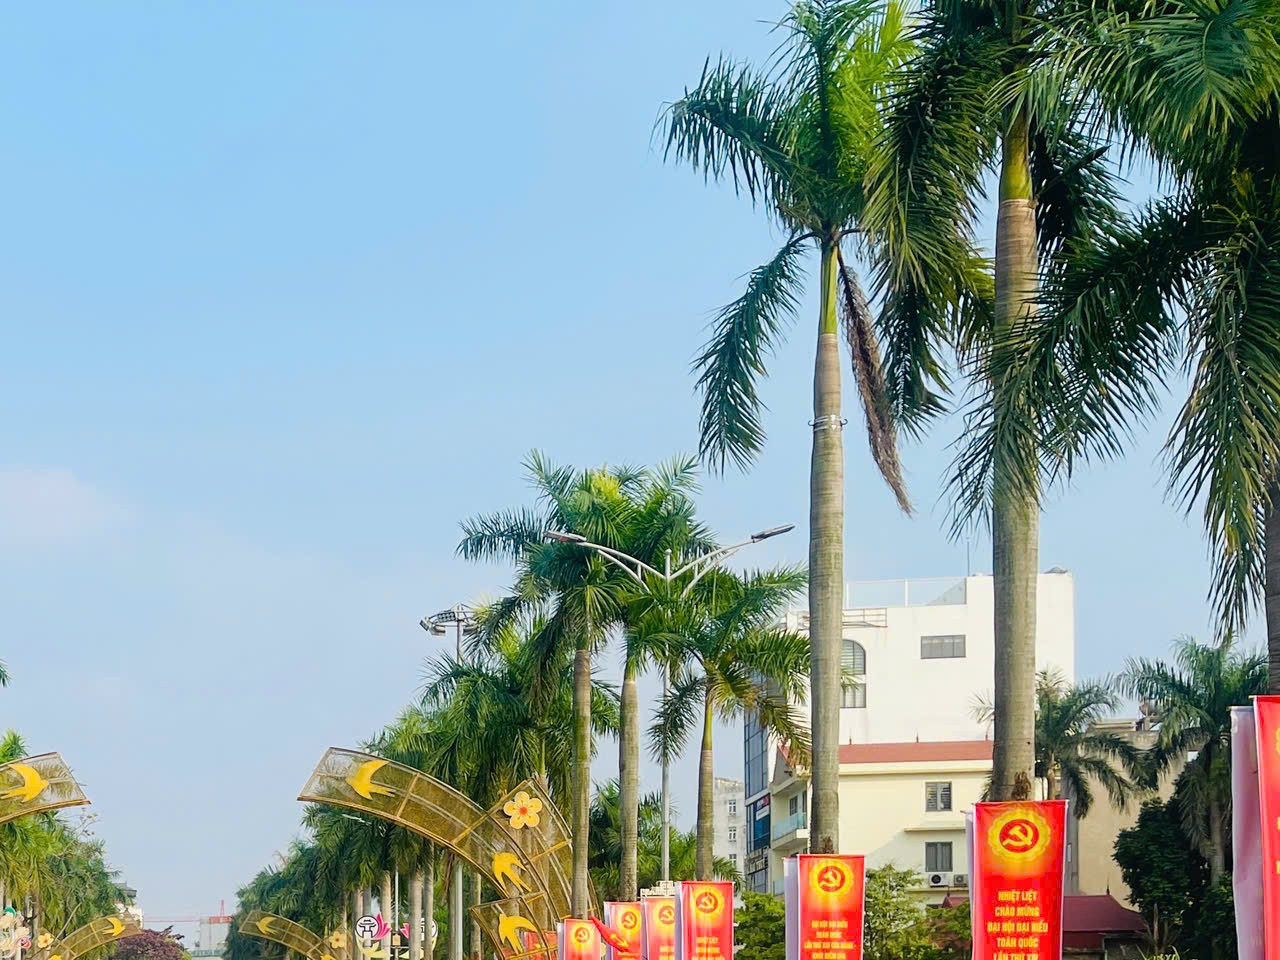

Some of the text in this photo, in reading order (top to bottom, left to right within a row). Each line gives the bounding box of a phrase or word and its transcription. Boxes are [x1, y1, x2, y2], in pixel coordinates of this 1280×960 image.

[998, 890, 1037, 904] NHIỆT LIỆT
[995, 905, 1015, 917] CHÀO
[1018, 935, 1039, 949] QUỐC
